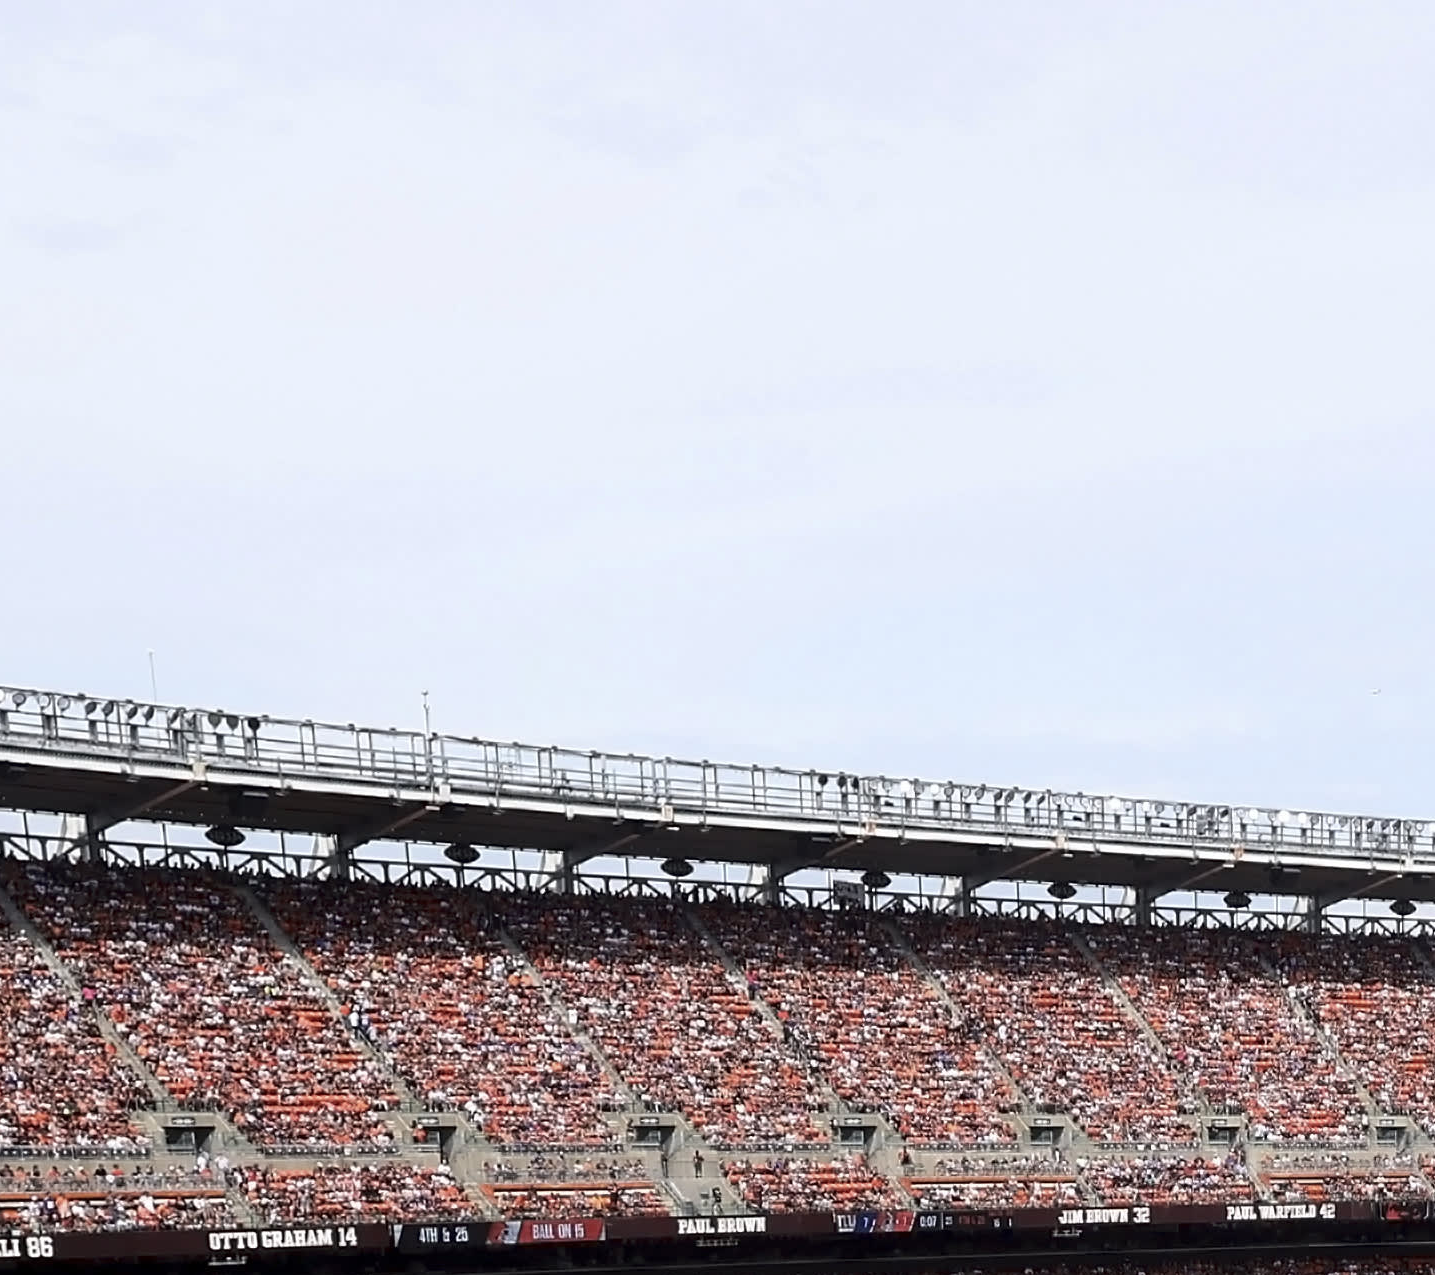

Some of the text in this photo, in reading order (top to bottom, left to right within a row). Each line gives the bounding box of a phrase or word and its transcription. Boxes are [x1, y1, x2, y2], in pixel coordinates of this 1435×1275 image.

[1058, 1207, 1150, 1224] JIM BROWN 32
[1226, 1203, 1336, 1219] PAUL WARFIELD 42
[677, 1216, 766, 1234] PAUL BROWN
[920, 1215, 937, 1227] 0:07
[209, 1227, 357, 1250] OTTO GRAHAM 14
[419, 1227, 438, 1242] 4TH
[532, 1222, 584, 1239] BALL ON 15
[26, 1237, 53, 1258] 86
